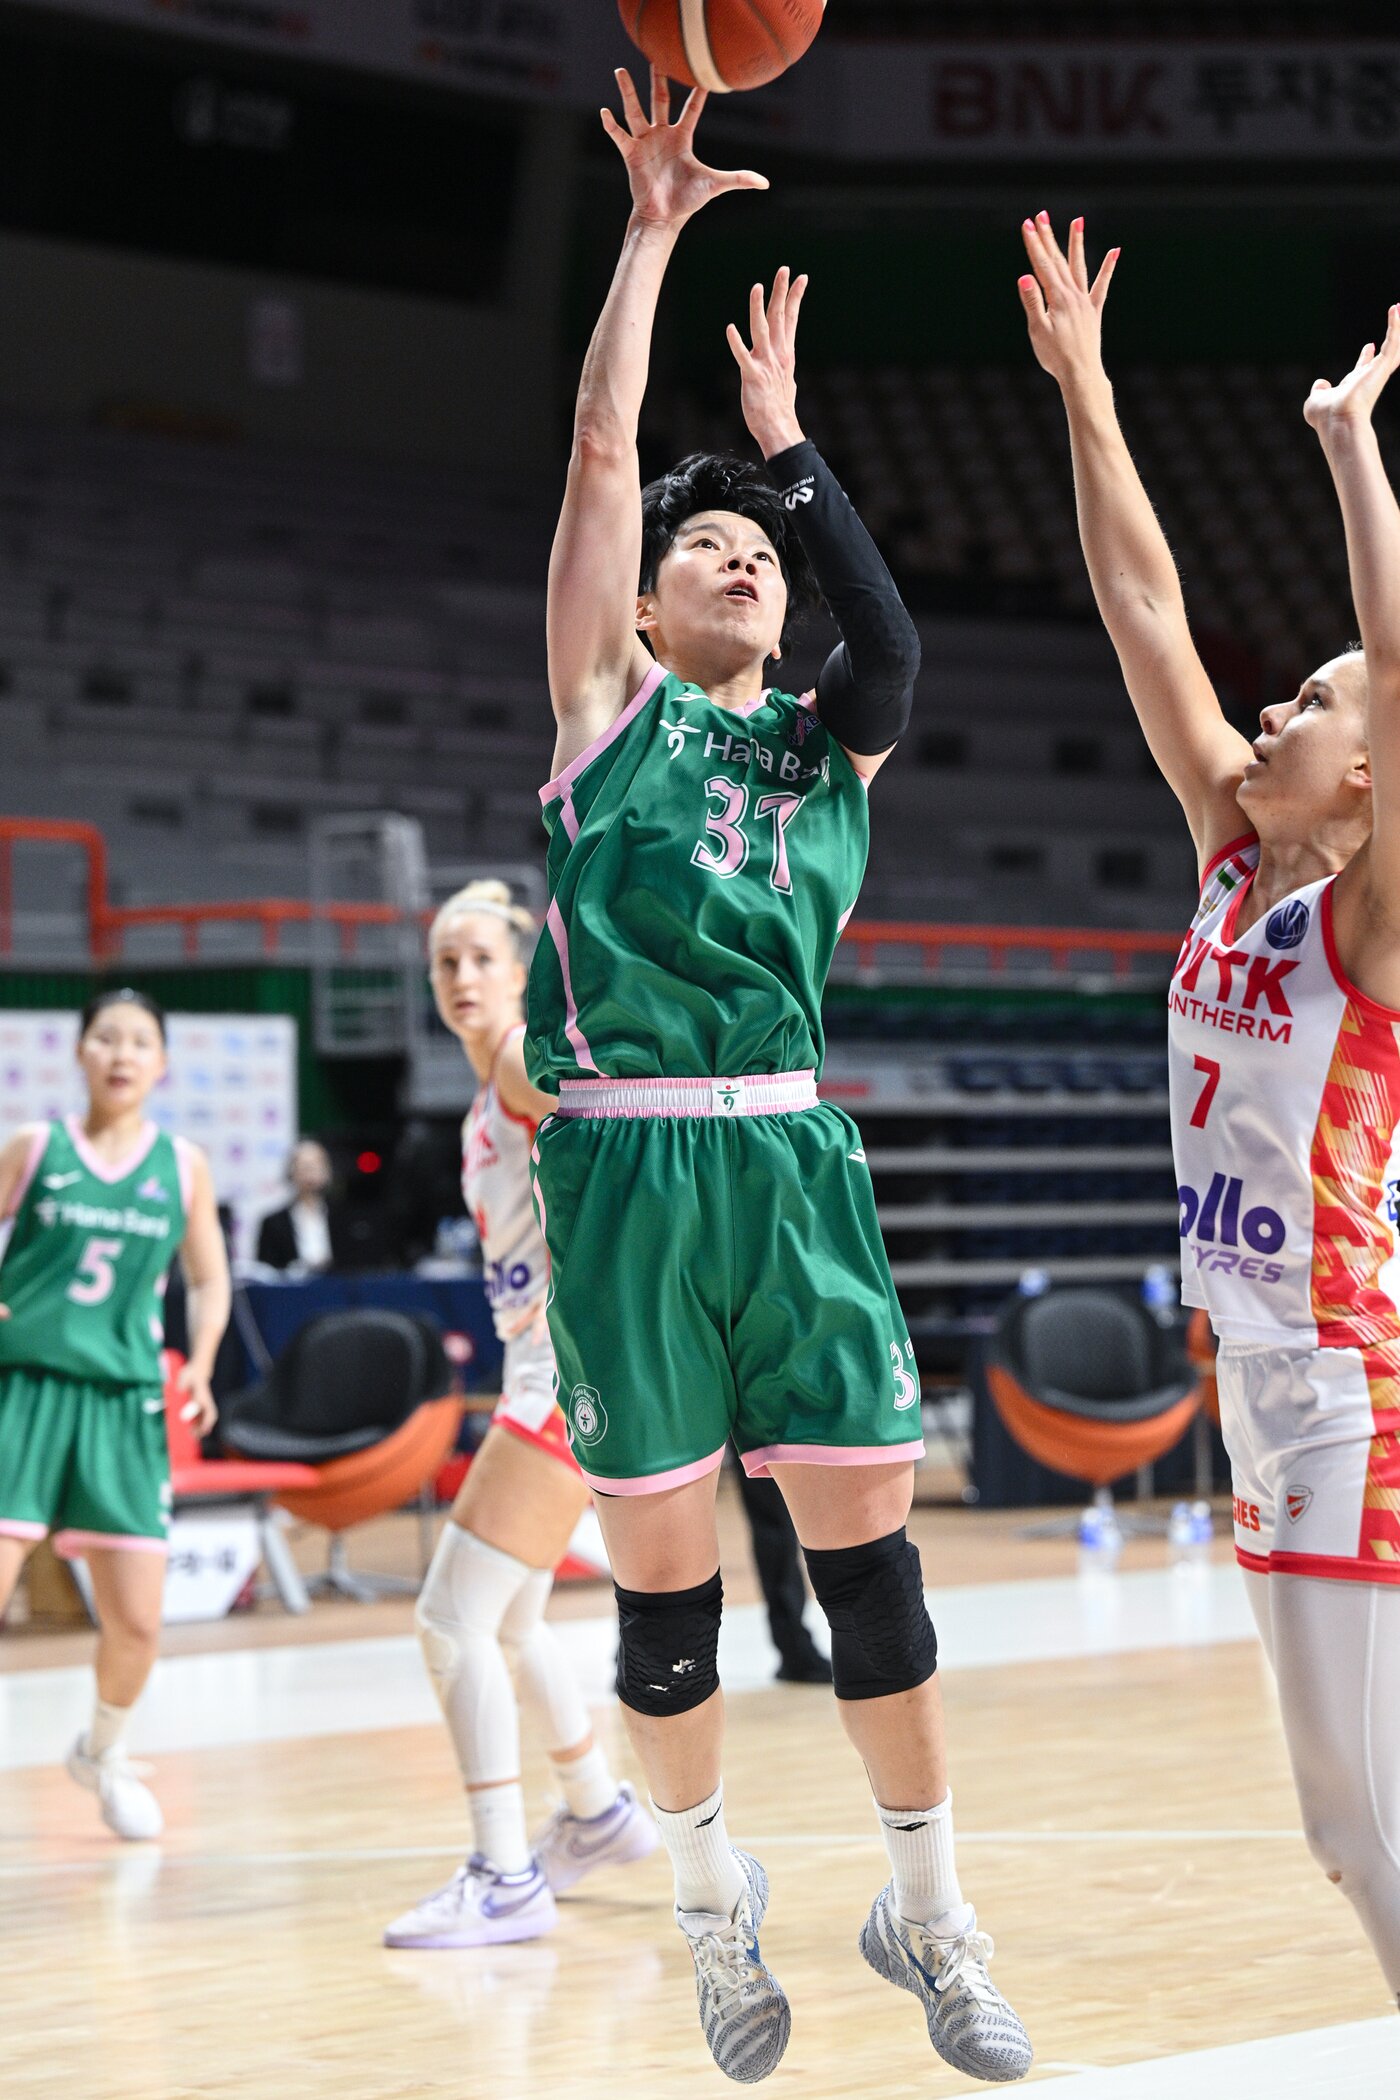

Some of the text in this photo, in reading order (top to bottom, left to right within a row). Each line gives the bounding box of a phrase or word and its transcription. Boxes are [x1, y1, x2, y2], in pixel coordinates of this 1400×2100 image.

[932, 57, 1172, 138] BNK
[690, 775, 807, 896] 37
[1189, 1054, 1221, 1129] 7
[66, 1235, 124, 1306] 5
